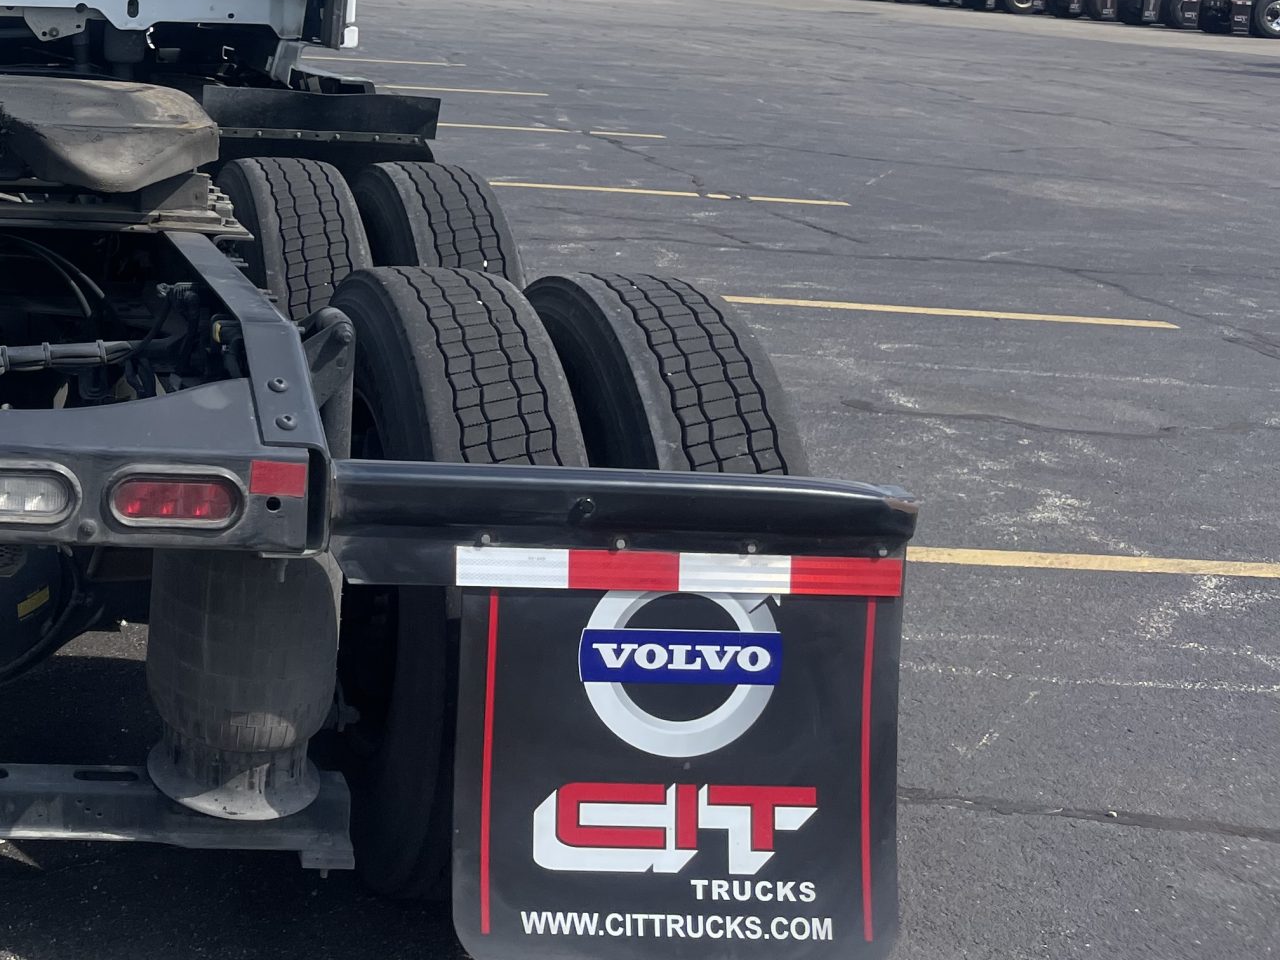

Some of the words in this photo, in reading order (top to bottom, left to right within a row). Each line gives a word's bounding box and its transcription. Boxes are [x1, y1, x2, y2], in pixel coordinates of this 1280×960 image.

[592, 643, 771, 672] VOLVO
[532, 782, 819, 876] CIT
[690, 879, 816, 903] TRUCKS
[520, 910, 834, 941] WWW.CITTRUCKS.COM
